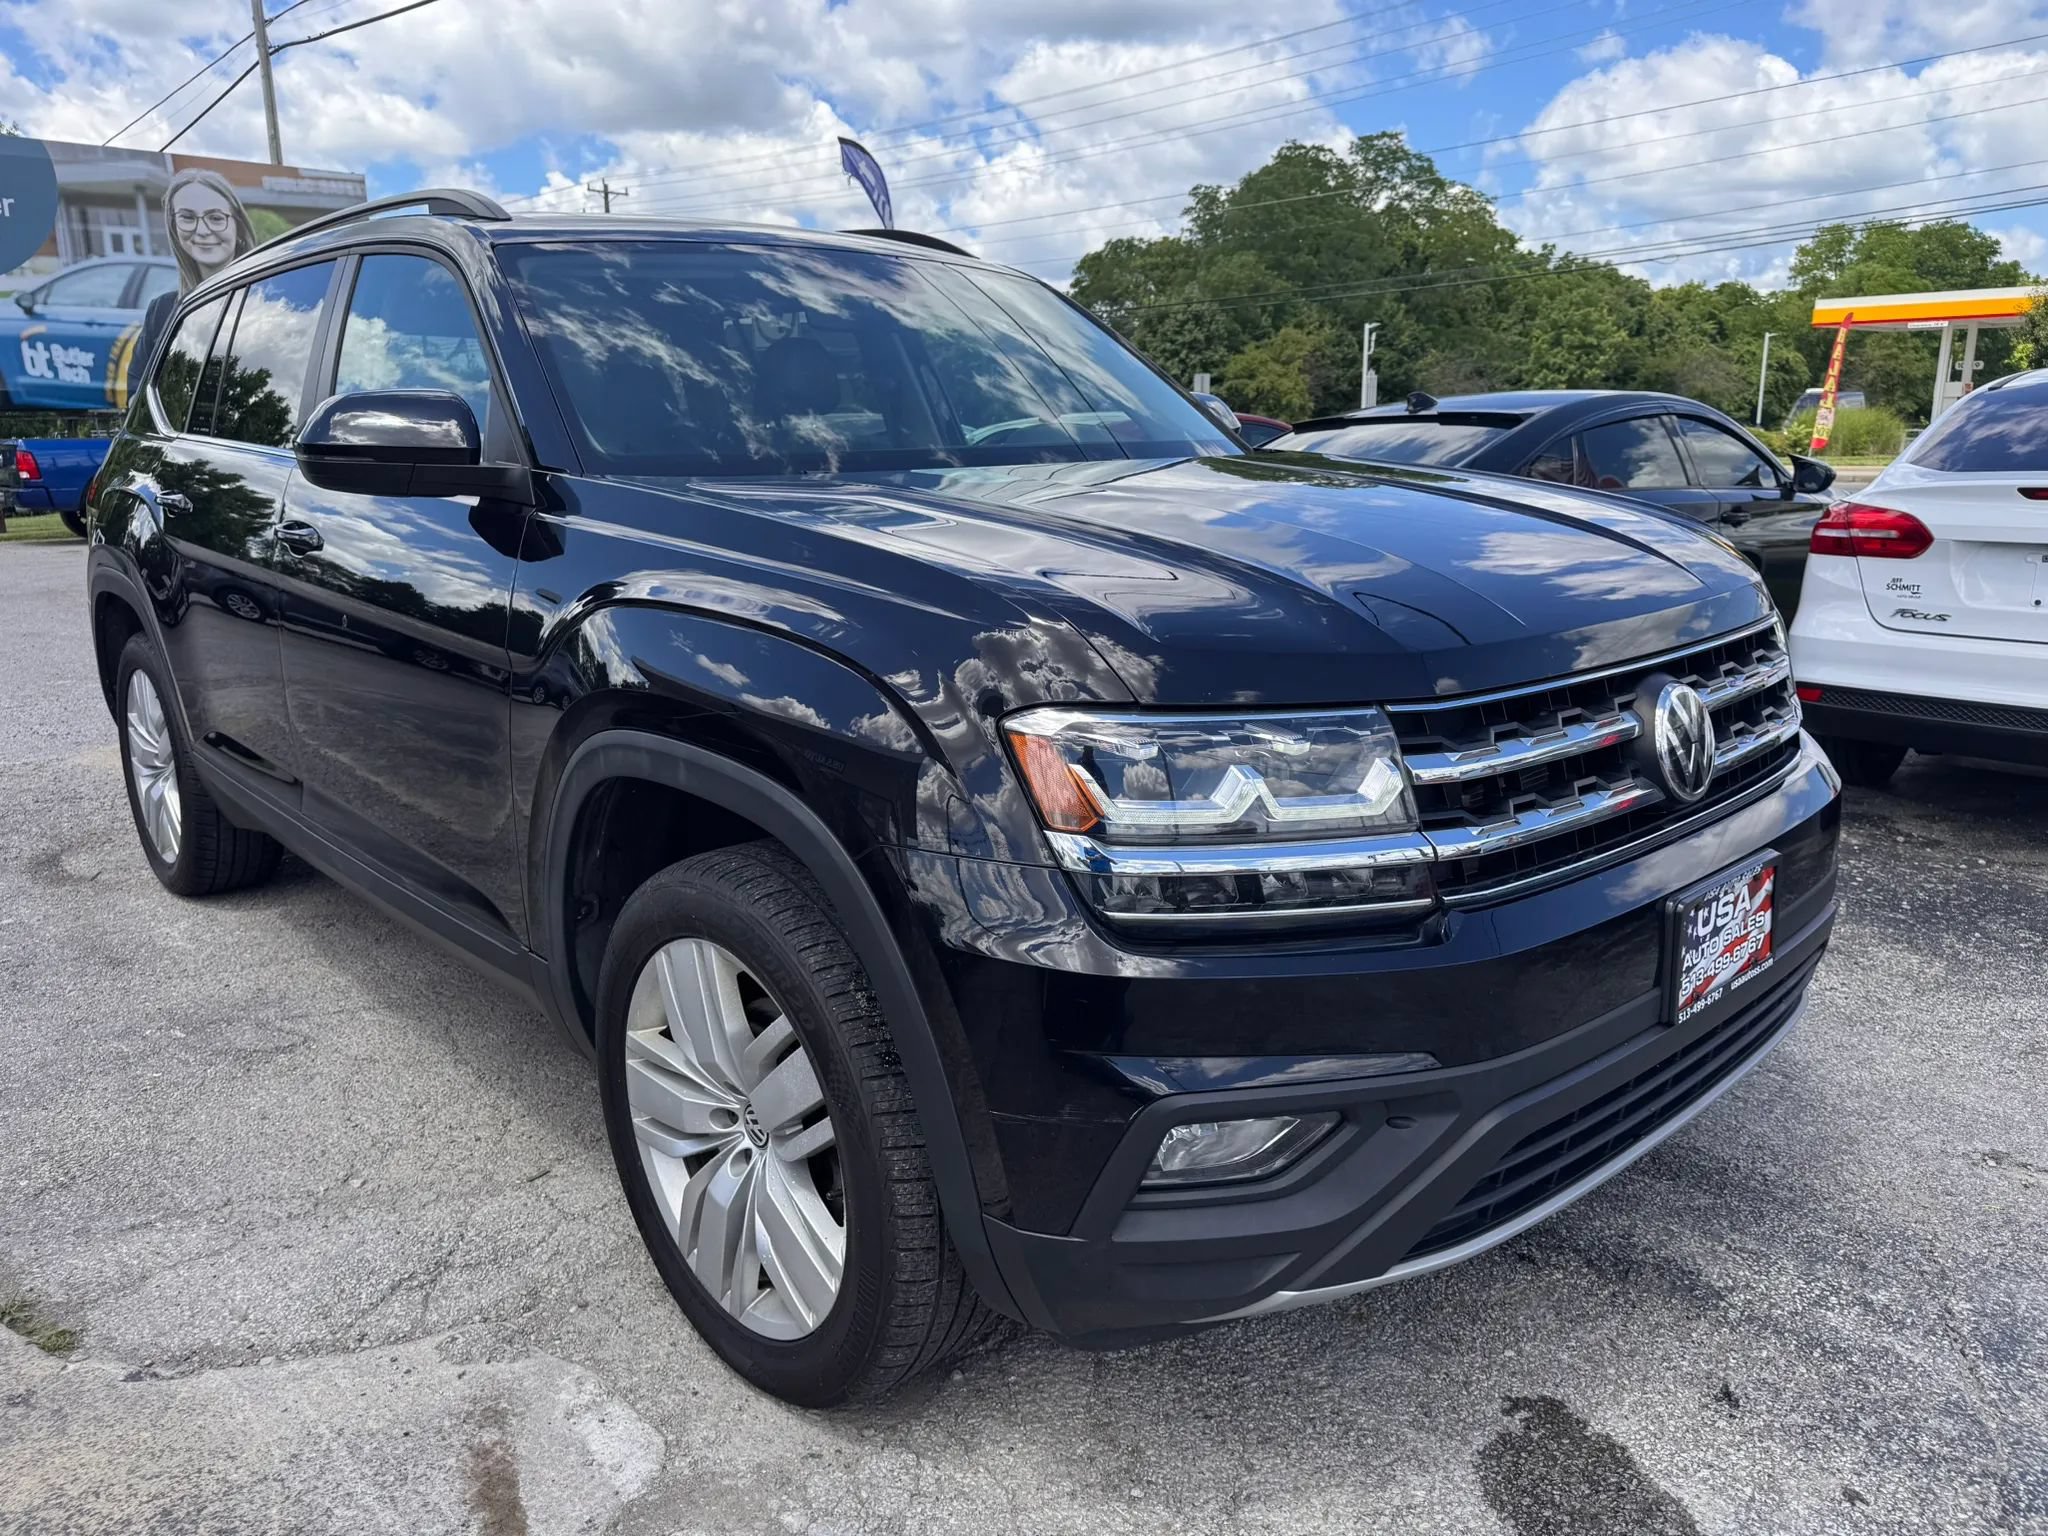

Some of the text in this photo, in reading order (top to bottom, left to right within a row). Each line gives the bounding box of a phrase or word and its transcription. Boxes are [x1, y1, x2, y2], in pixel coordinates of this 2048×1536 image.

[1886, 582, 1921, 592] SCHMITT
[1697, 884, 1752, 937] USA
[1682, 911, 1765, 972] AUTO SALES
